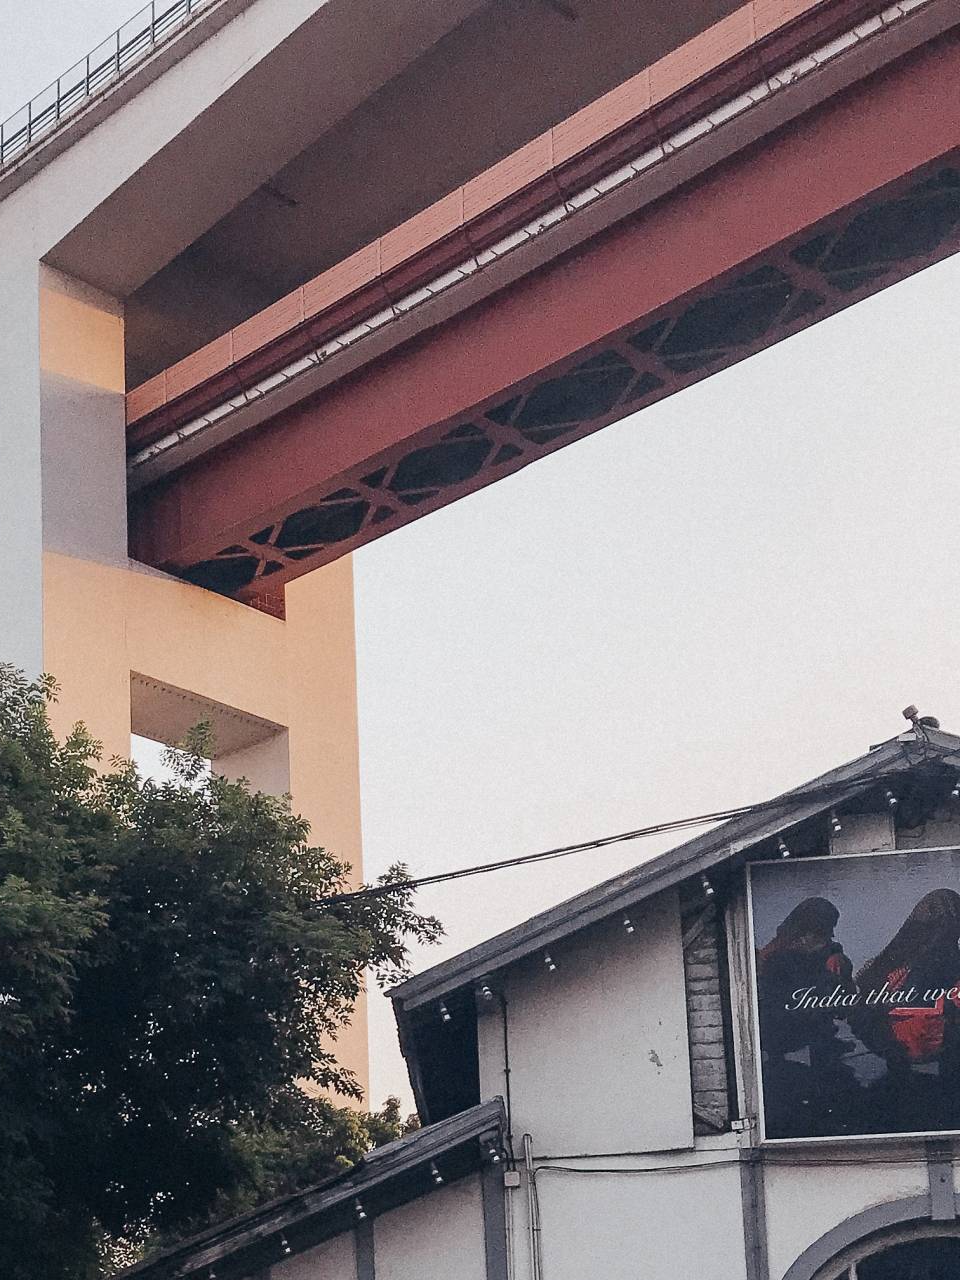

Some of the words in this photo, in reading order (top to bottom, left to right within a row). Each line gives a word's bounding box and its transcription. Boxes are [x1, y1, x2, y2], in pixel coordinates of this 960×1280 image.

[785, 985, 859, 1011] India
[865, 981, 918, 1005] that
[922, 986, 960, 1002] we
